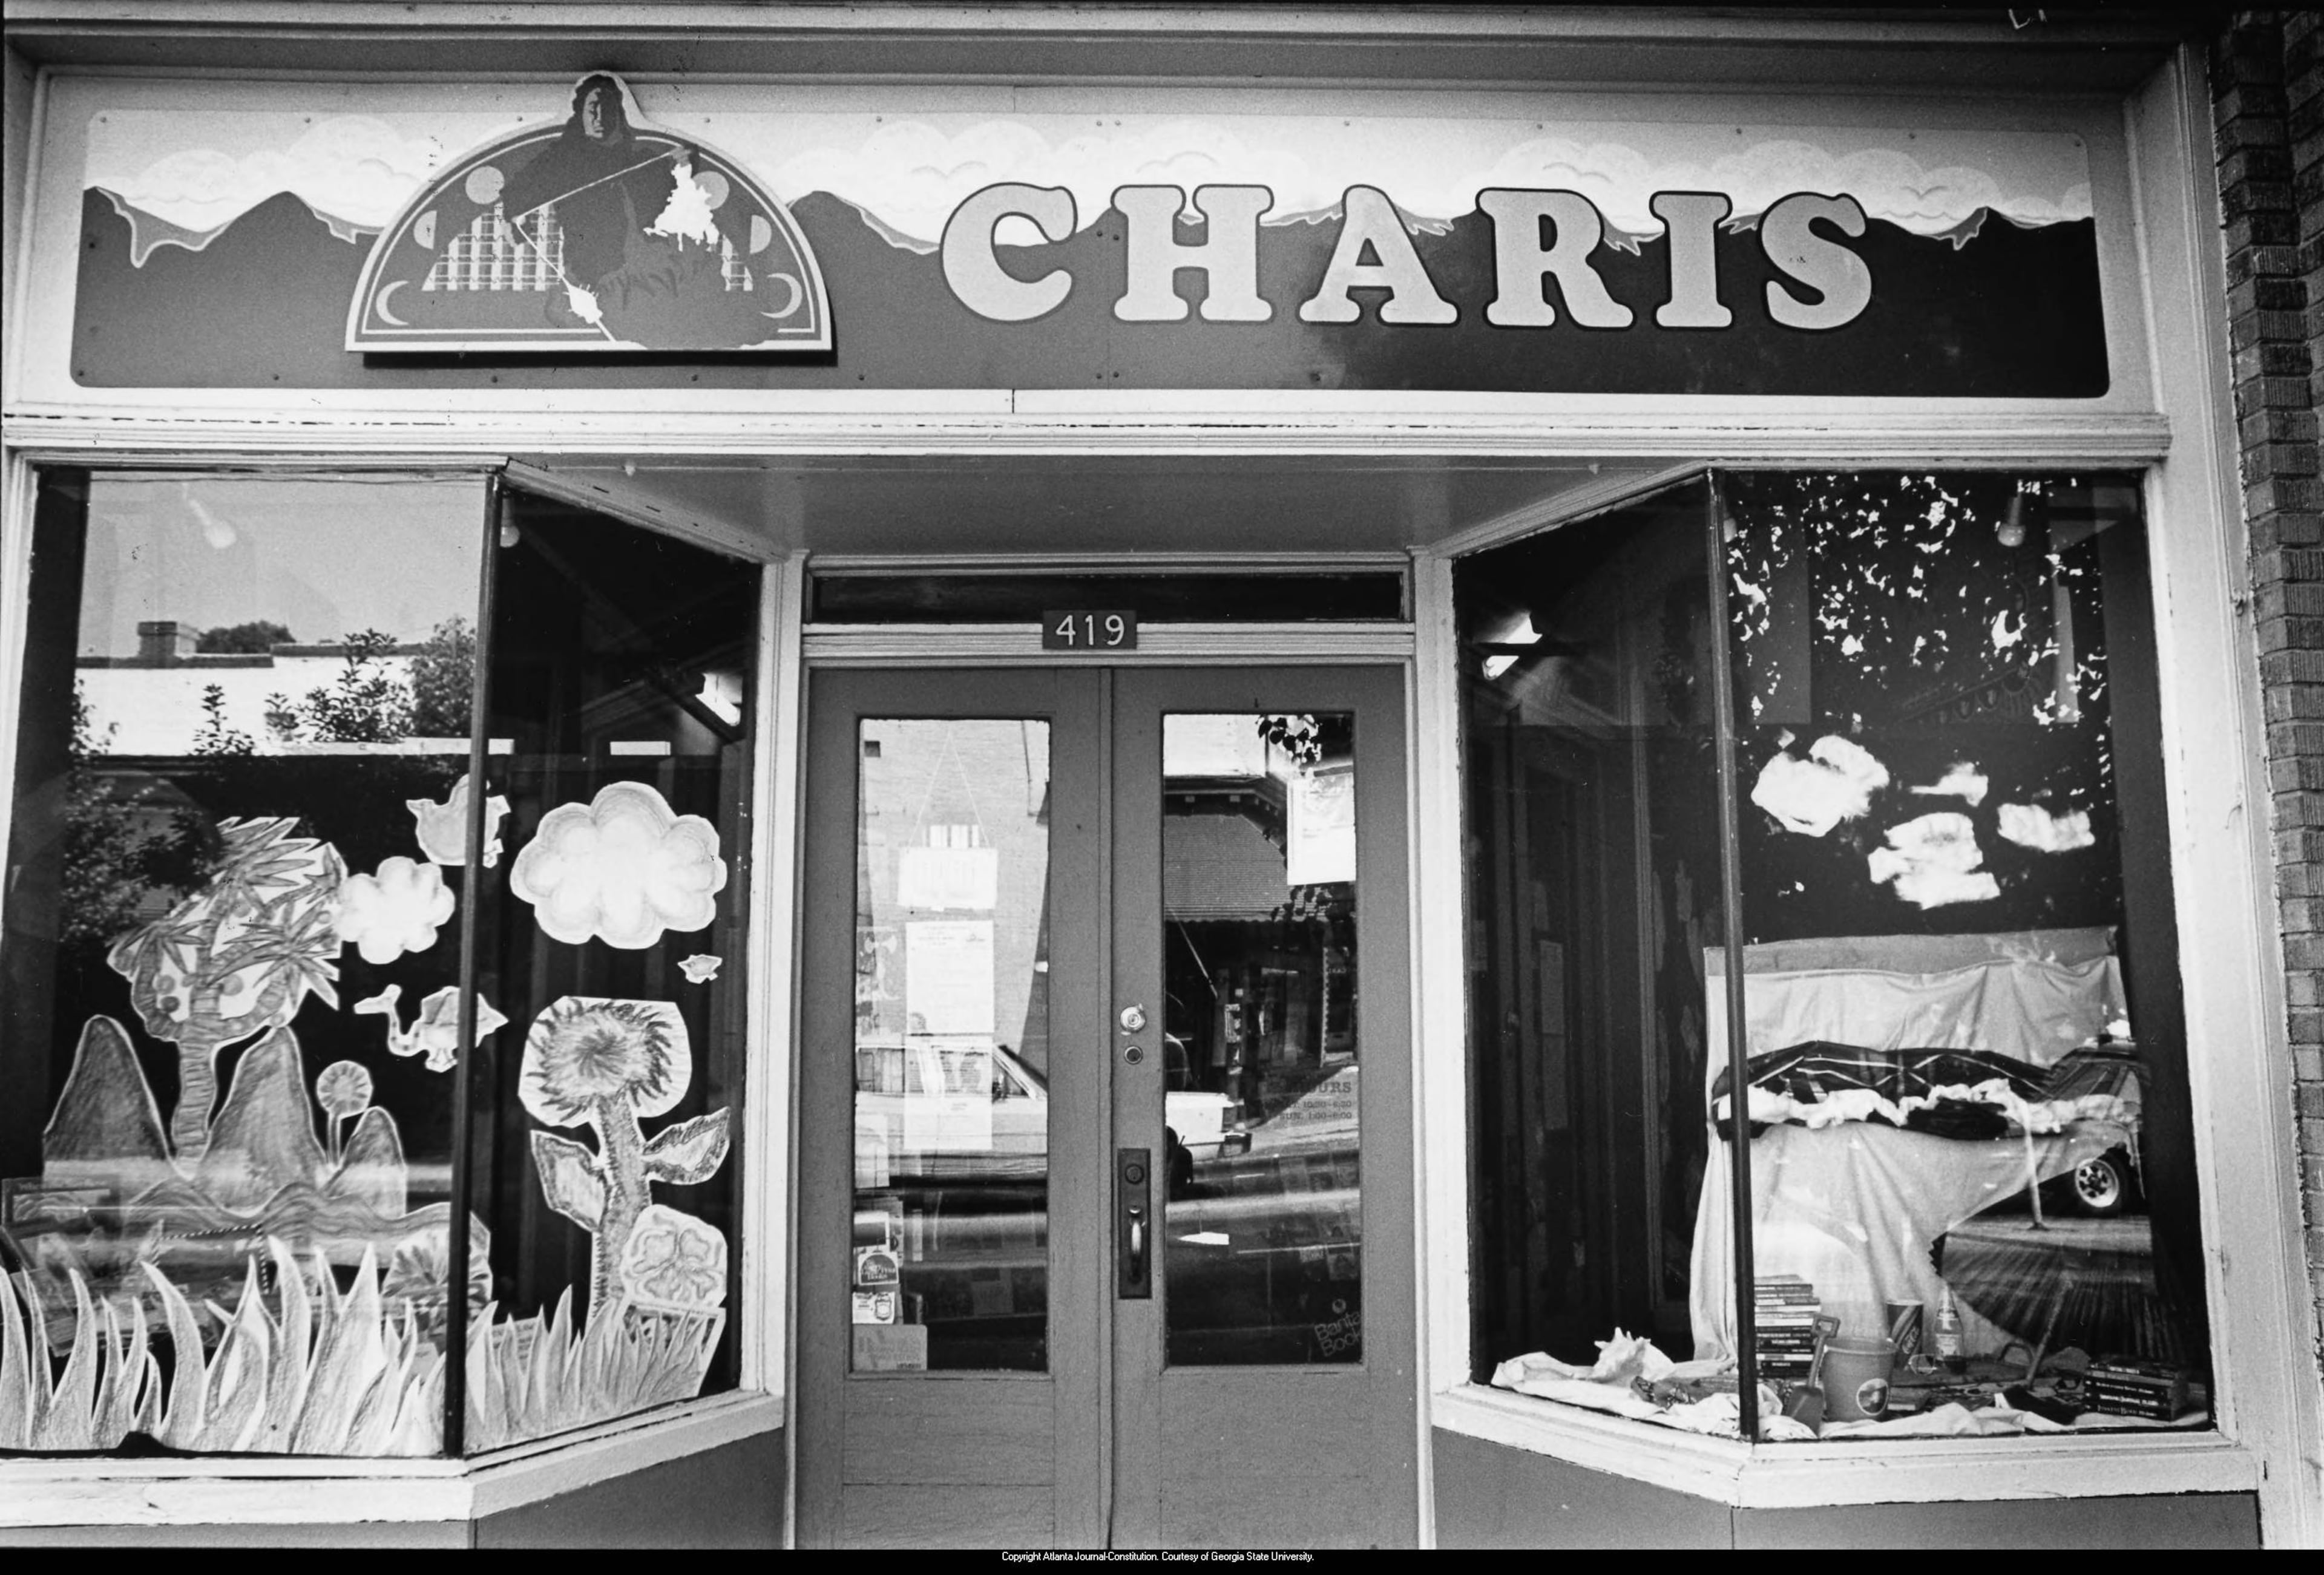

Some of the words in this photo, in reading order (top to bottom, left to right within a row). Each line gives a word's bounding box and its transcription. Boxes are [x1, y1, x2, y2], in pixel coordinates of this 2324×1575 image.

[939, 182, 1874, 331] CHARIS
[1055, 614, 1125, 646] 419
[1307, 1081, 1351, 1093] URS
[1315, 1312, 1361, 1341] Banta
[1321, 1327, 1361, 1357] Book
